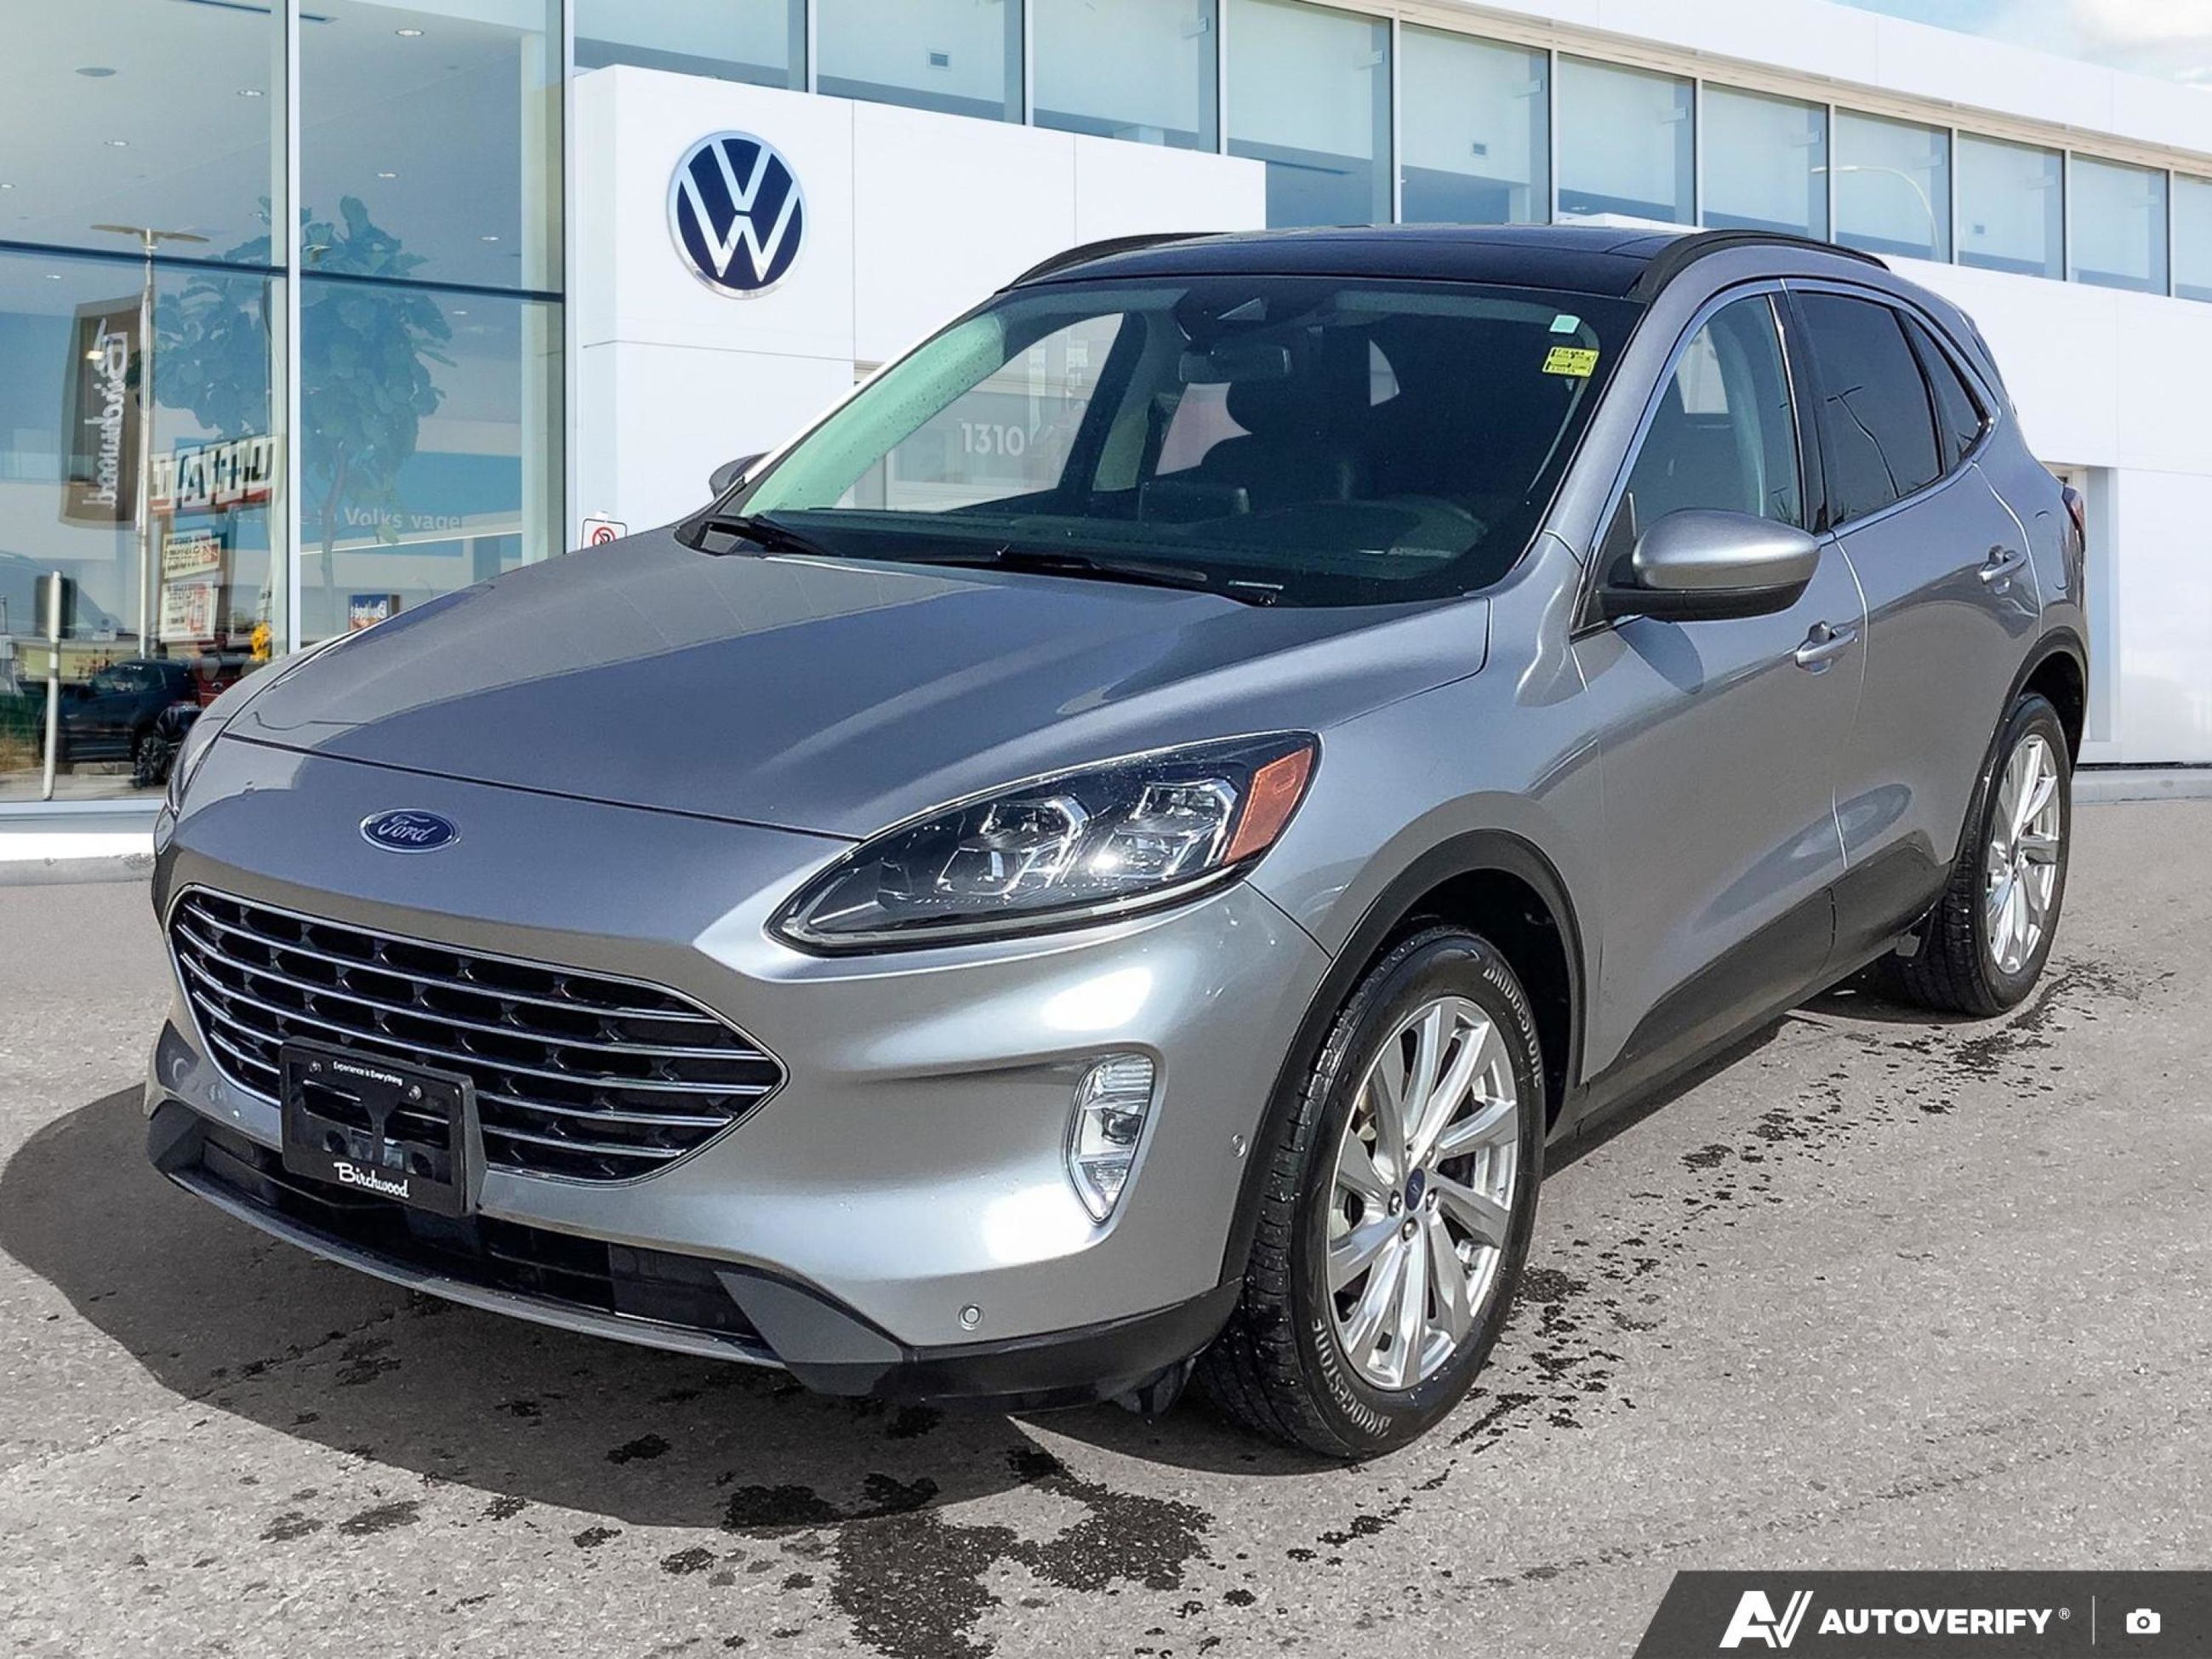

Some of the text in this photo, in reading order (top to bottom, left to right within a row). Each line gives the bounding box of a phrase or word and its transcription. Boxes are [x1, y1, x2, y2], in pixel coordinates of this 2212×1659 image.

[961, 423, 1025, 457] 1310
[379, 813, 437, 842] Ford
[333, 1161, 410, 1198] Birchwood
[1311, 1318, 1393, 1439] BRIDGESTONE
